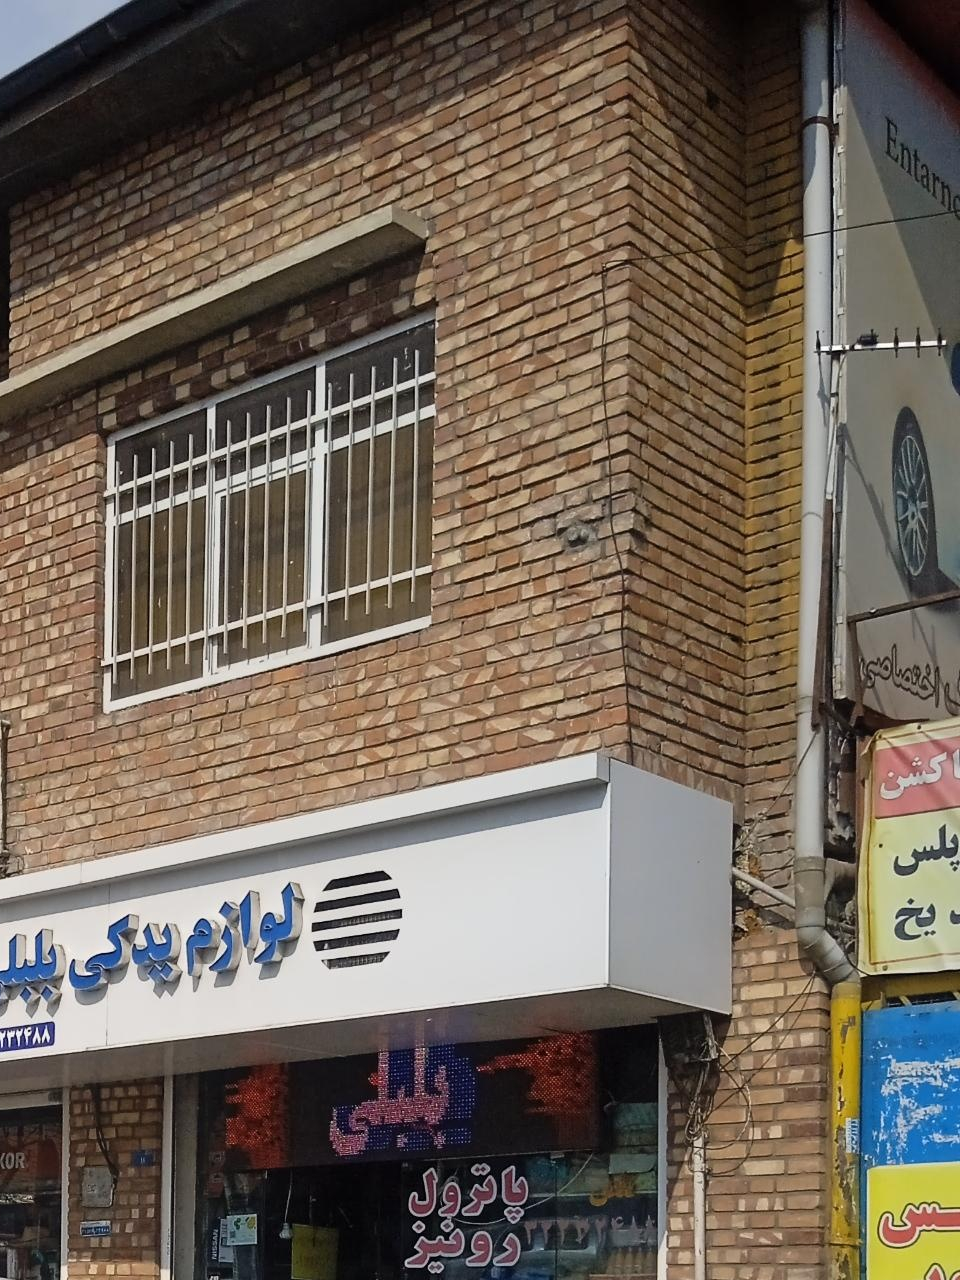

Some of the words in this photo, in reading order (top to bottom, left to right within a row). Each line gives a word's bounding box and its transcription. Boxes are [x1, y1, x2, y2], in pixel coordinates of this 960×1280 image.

[69, 914, 182, 991] یدکی
[186, 882, 305, 976] لوازم
[408, 1163, 529, 1224] پاترول
[404, 1220, 521, 1274] رونیز
